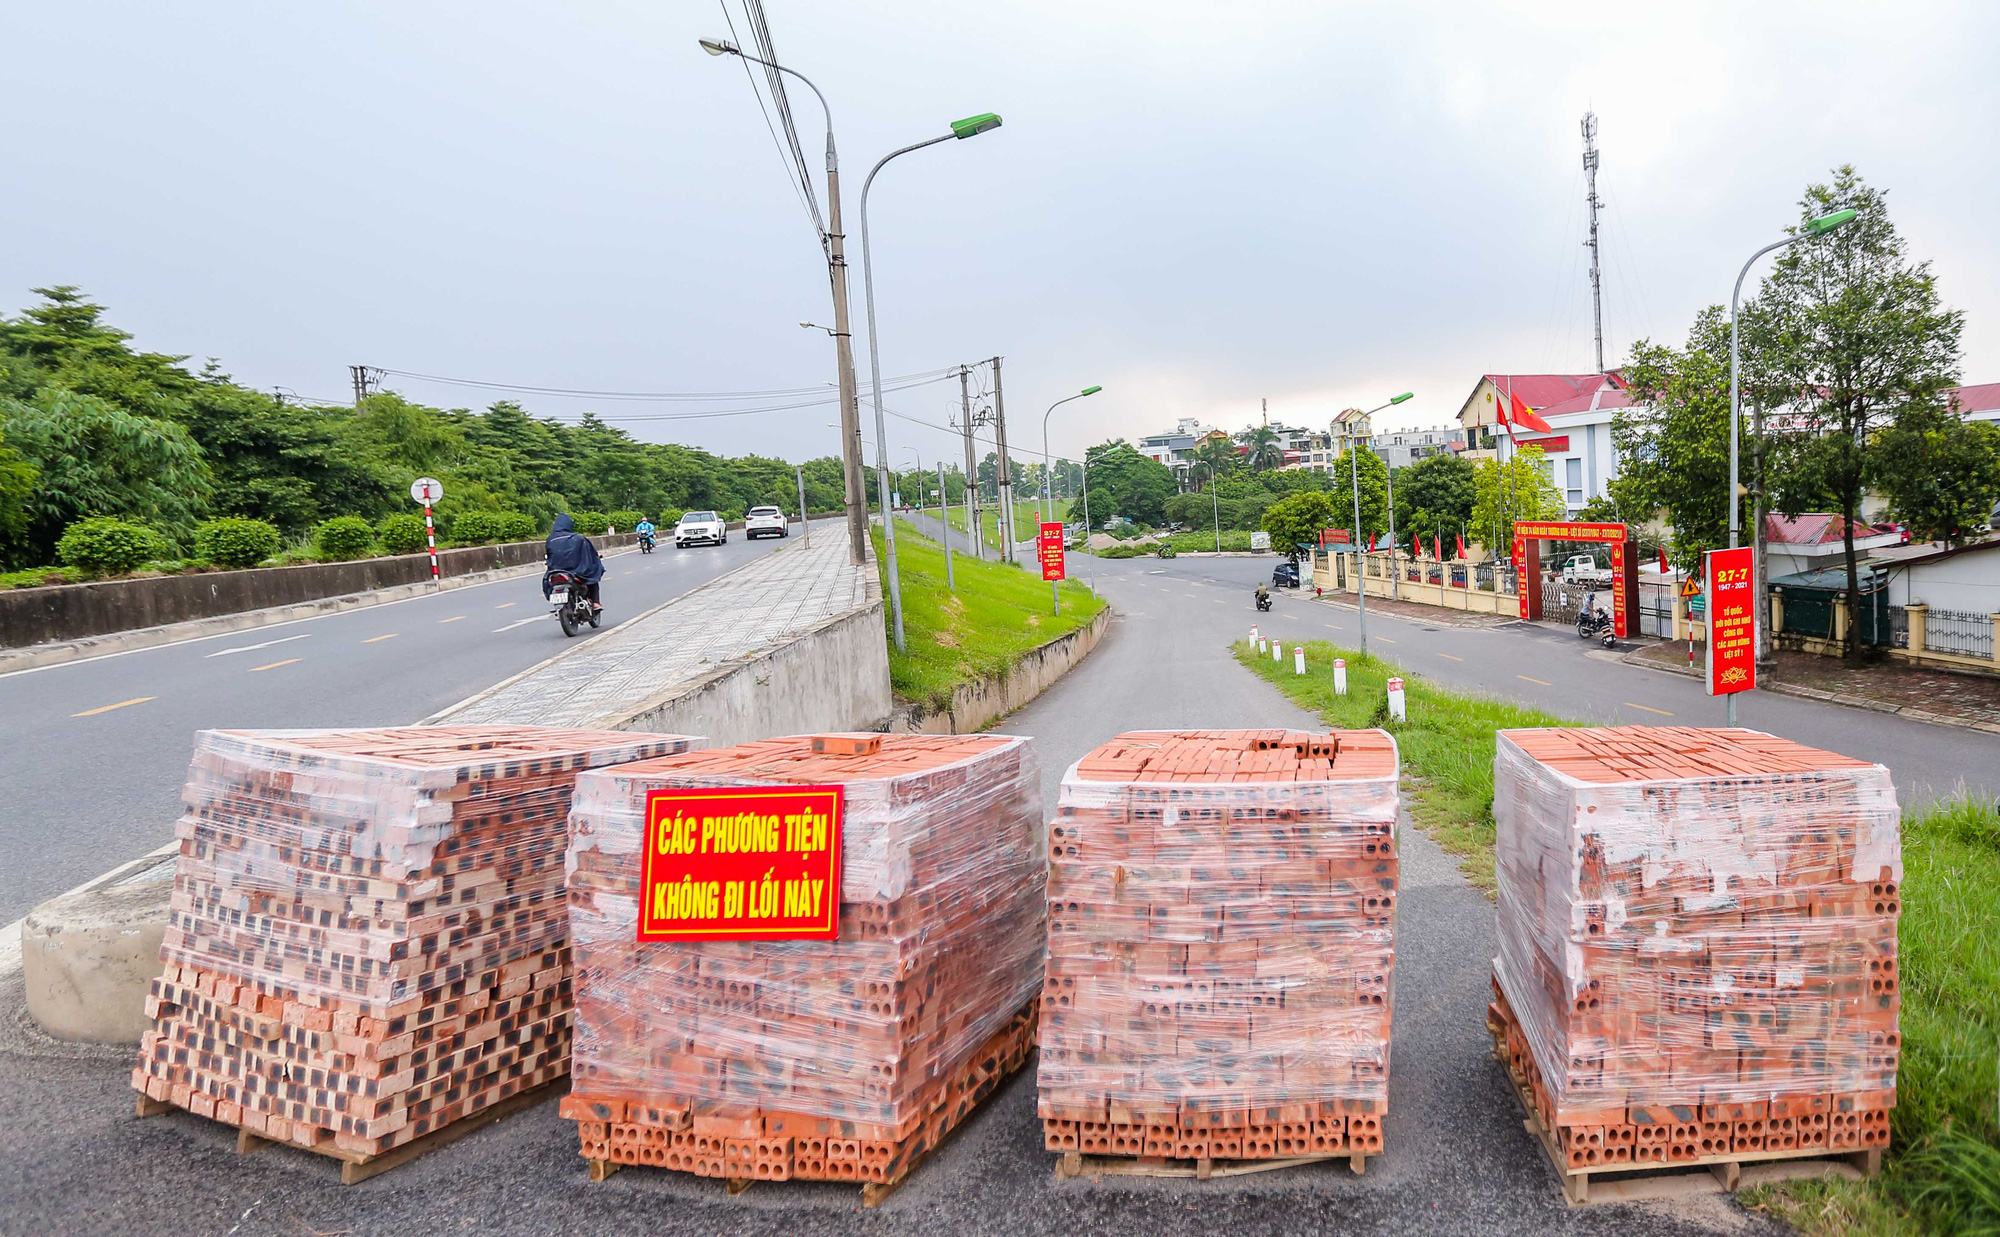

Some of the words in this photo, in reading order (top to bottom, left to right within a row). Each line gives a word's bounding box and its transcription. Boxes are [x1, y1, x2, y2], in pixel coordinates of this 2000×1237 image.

[1718, 568, 1748, 582] 27-7
[1731, 605, 1742, 616] QUỐC
[1717, 640, 1726, 649] CÁC
[657, 810, 697, 855] CÁC
[701, 812, 780, 854] PHƯƠNG
[784, 806, 827, 860] TIỆN
[653, 874, 720, 920] KHÔNG
[724, 880, 744, 918] ĐI
[749, 866, 779, 918] LỐI
[784, 871, 824, 917] NÀY
